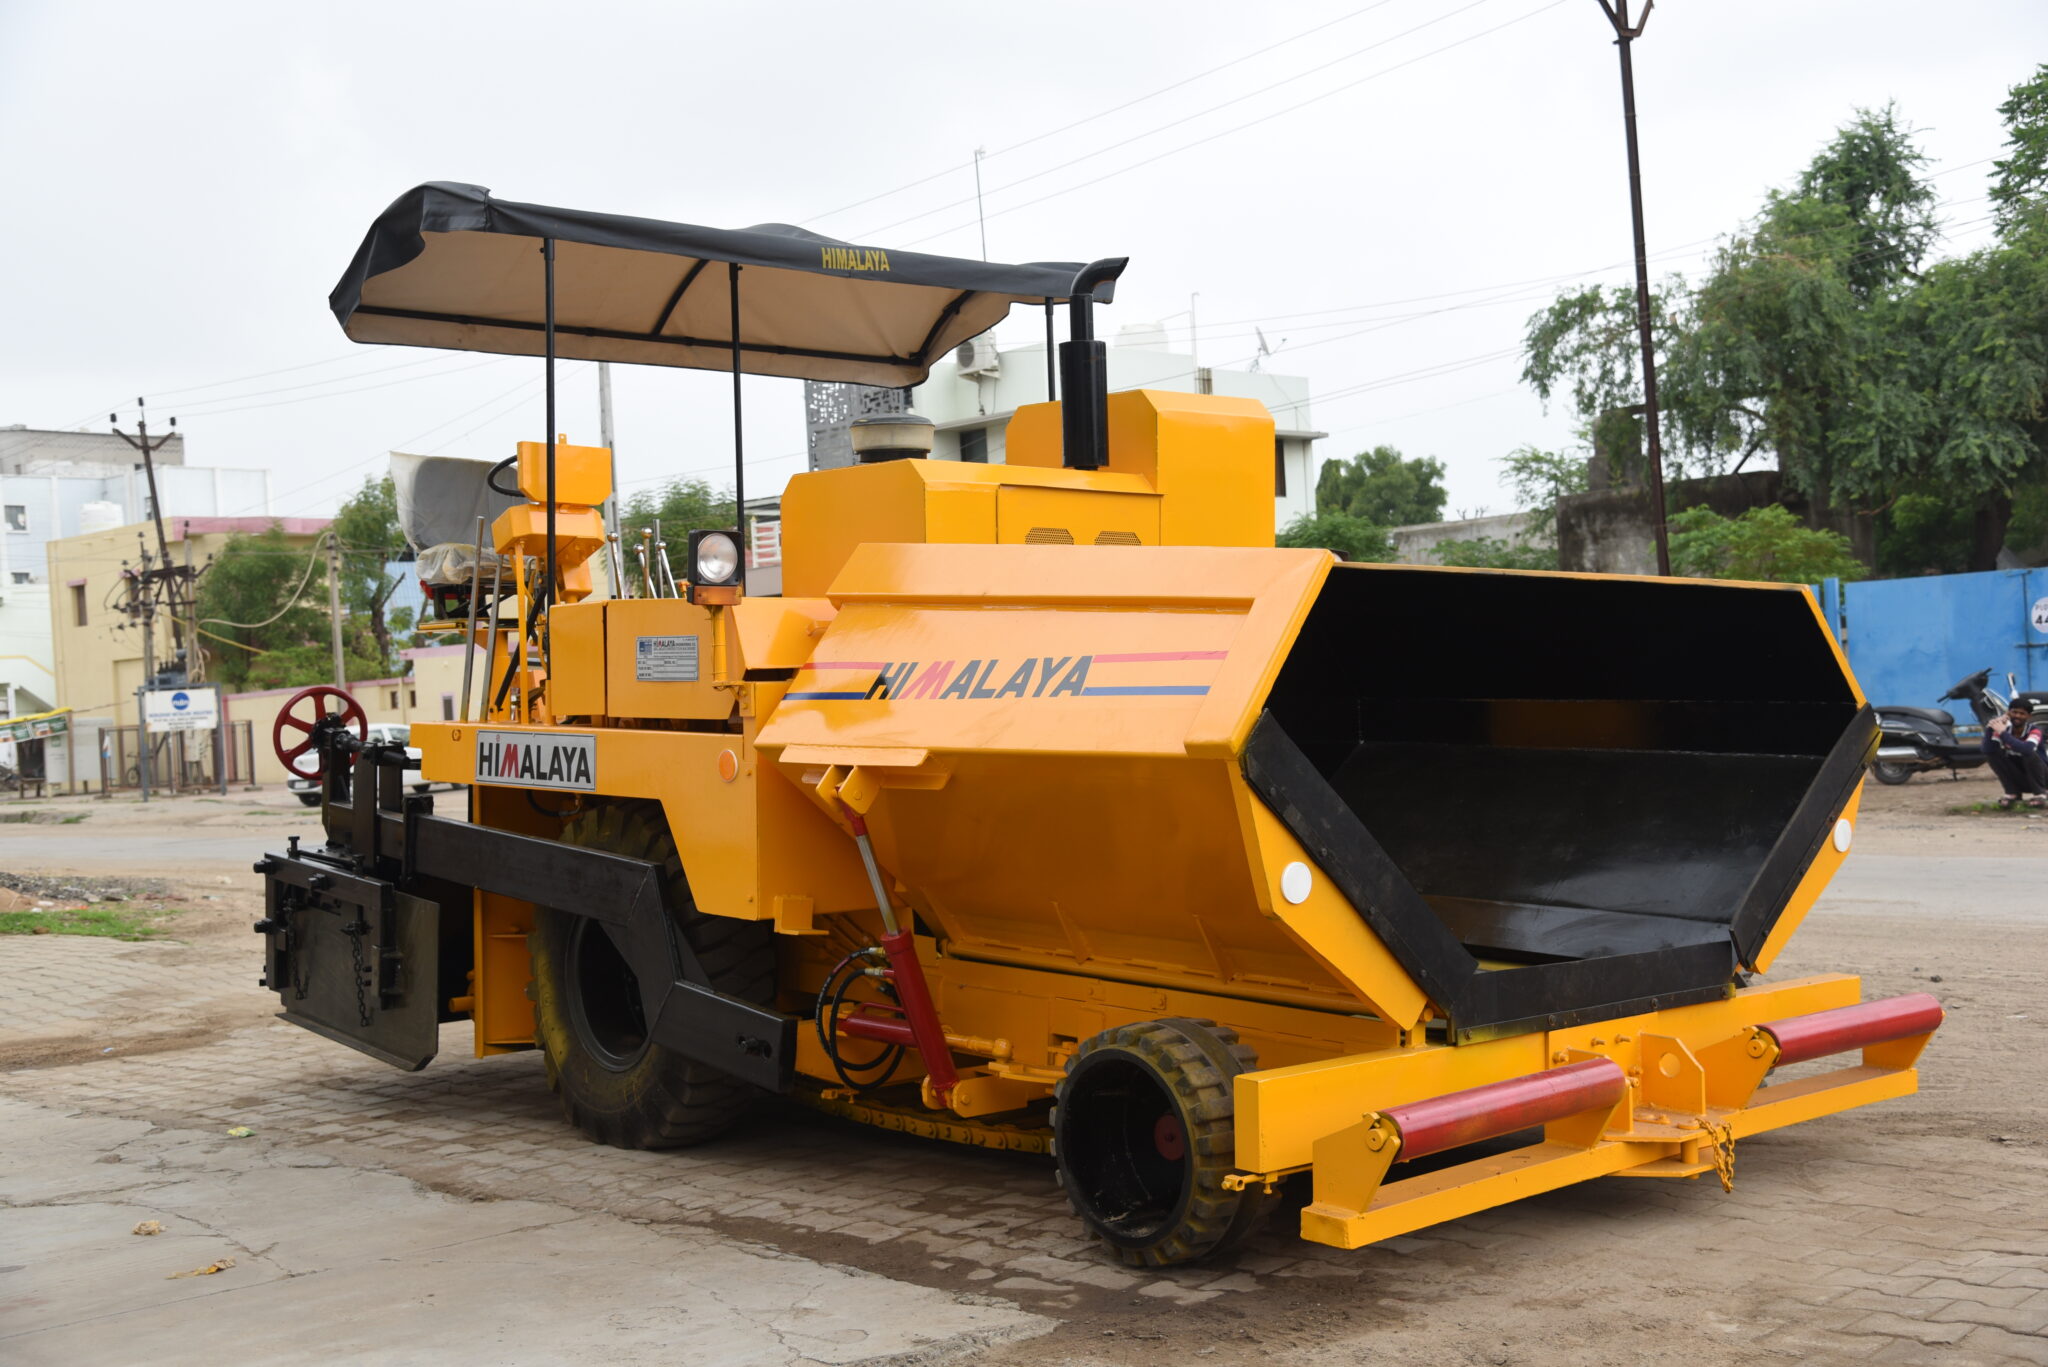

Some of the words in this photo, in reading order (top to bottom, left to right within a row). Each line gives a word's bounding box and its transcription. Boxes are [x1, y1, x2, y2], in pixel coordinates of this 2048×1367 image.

[820, 247, 891, 272] HIMALAYA
[862, 655, 1093, 700] HIMALAYA
[478, 741, 592, 784] HIMALAYA
